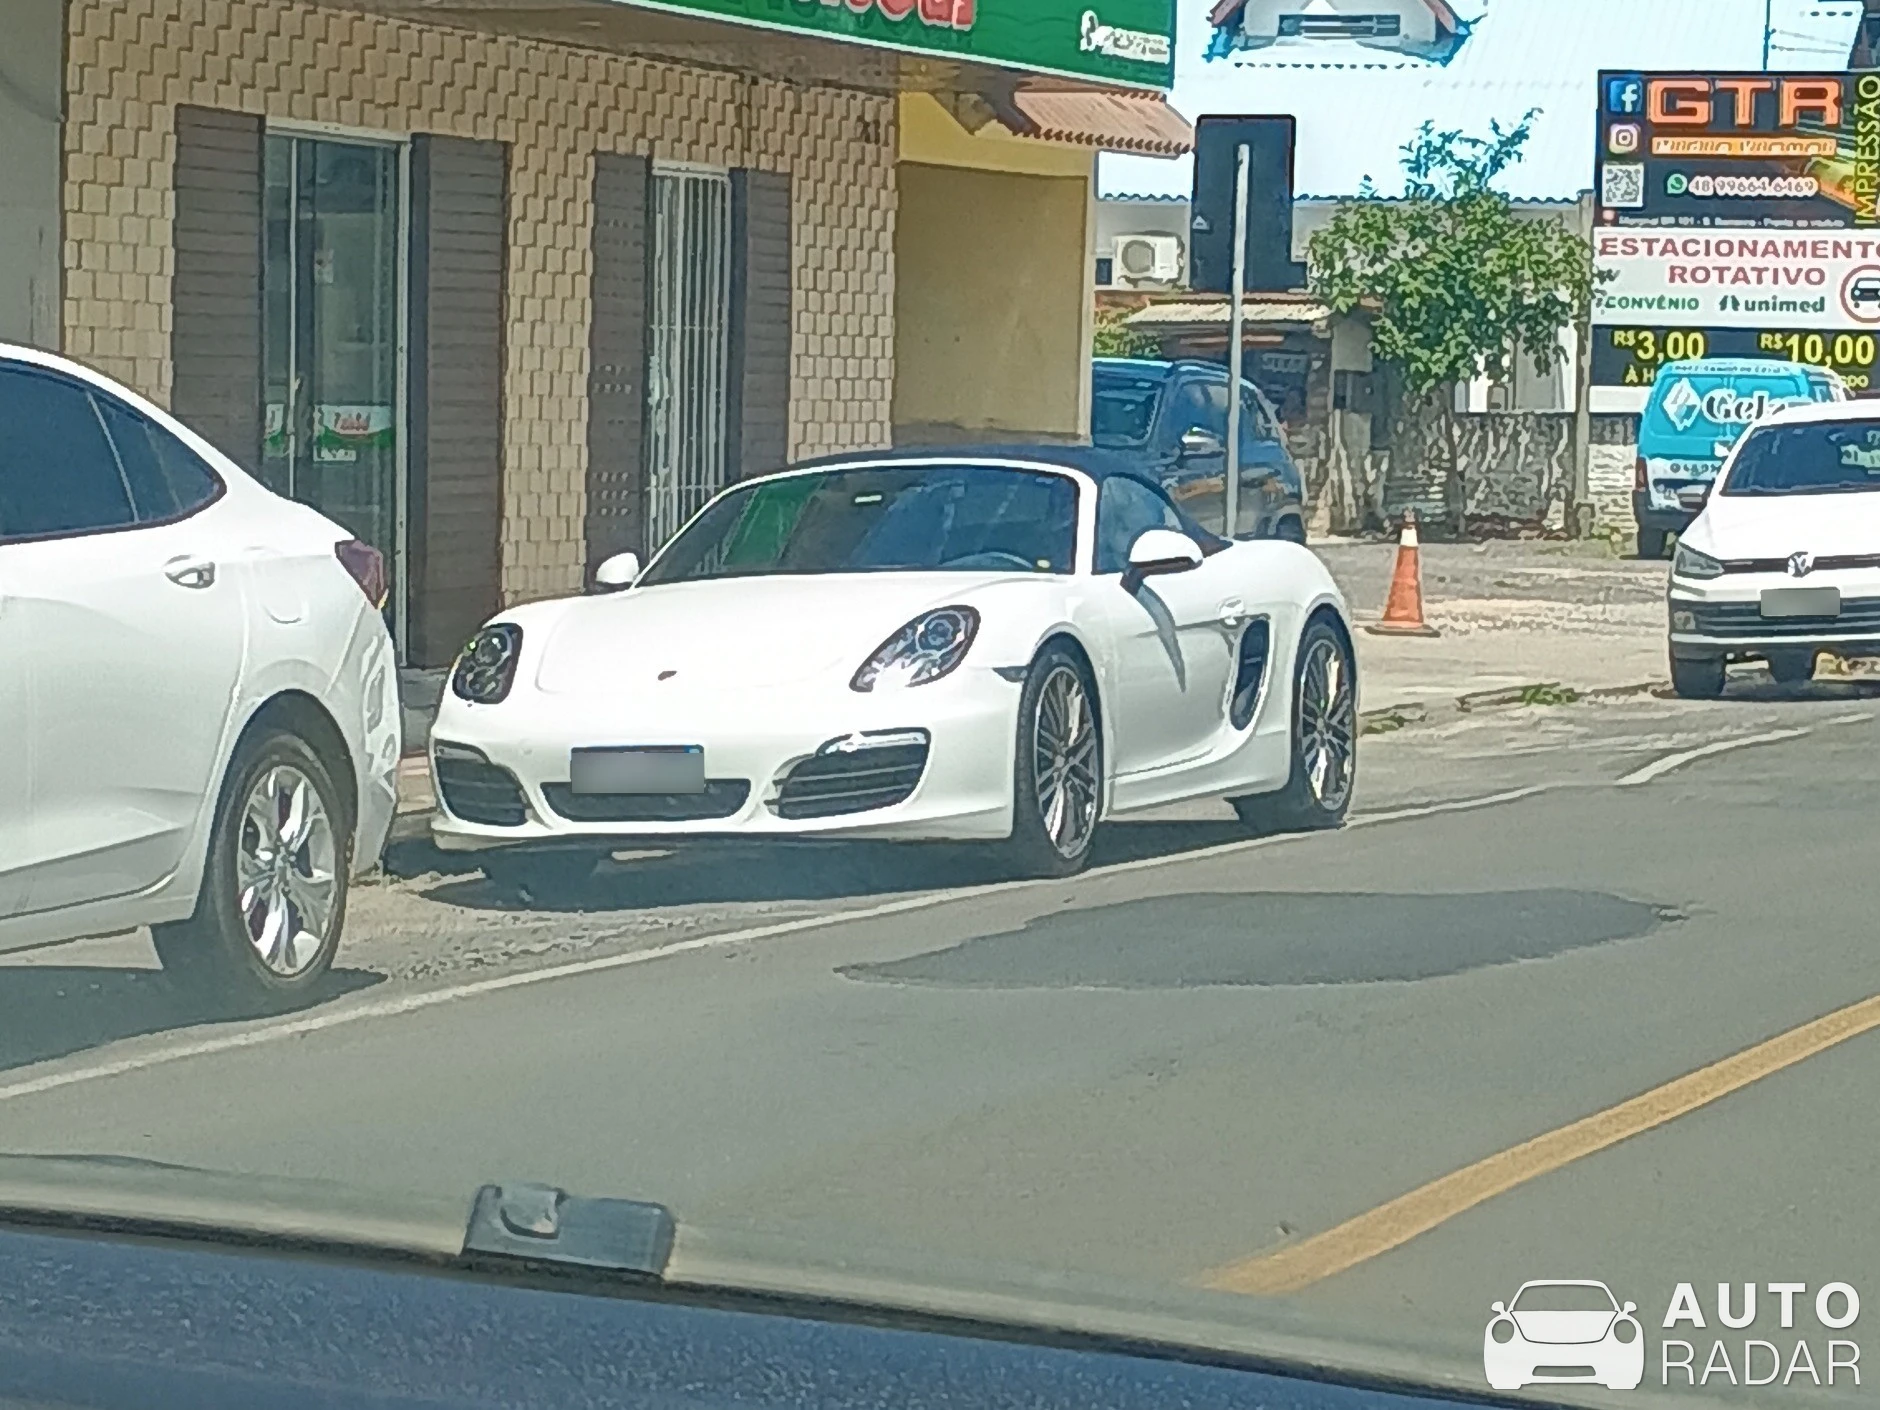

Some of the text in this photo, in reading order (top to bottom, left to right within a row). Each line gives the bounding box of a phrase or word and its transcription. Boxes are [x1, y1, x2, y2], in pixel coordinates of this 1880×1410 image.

[1621, 84, 1637, 112] f
[1649, 80, 1840, 126] GTR
[1854, 75, 1880, 224] IMPRESSÃO
[1599, 237, 1880, 258] ESTACIONAMENT
[1669, 265, 1826, 285] ROTATIVO
[1744, 295, 1825, 313] unimed
